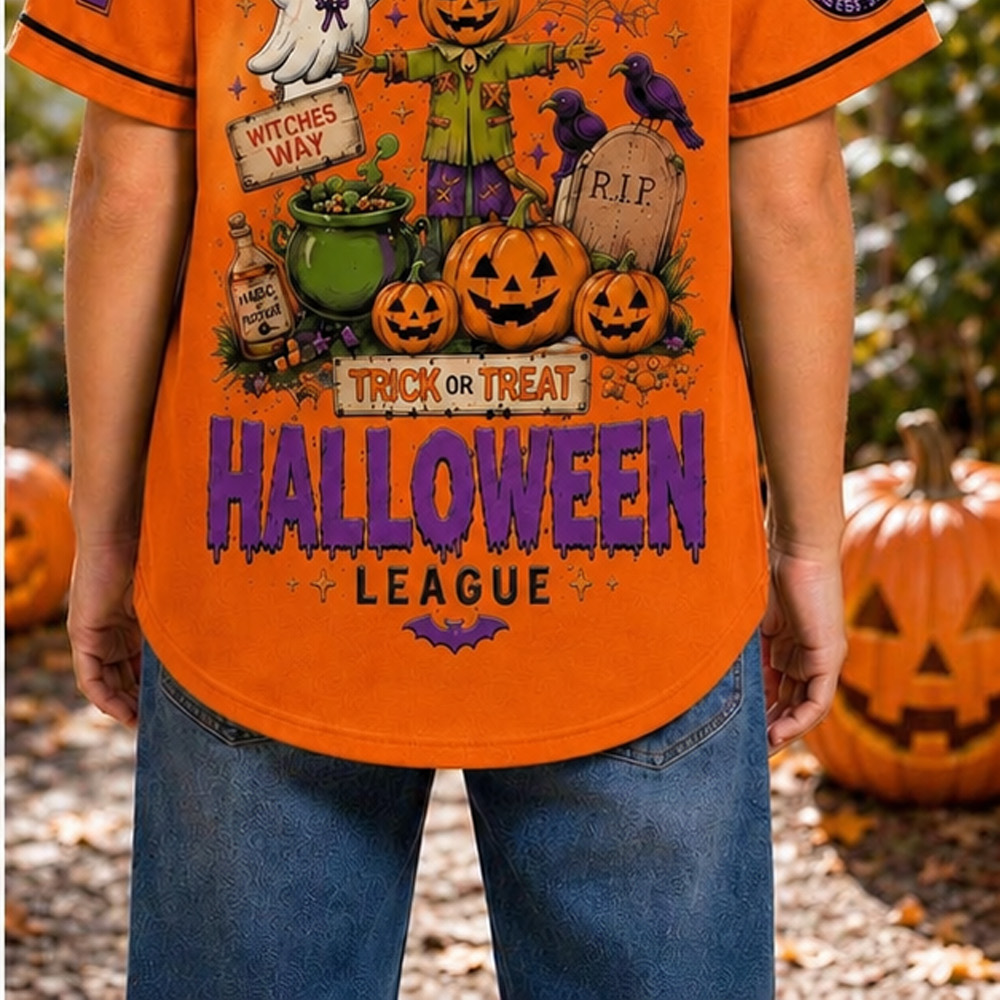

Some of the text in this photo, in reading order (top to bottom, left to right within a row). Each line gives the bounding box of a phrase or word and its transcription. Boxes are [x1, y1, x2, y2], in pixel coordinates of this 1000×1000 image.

[245, 103, 338, 148] WITCHES
[266, 131, 324, 168] WAY
[348, 365, 575, 403] TRICK OR TREAT
[206, 411, 705, 564] HALLOWEEN
[356, 565, 550, 605] LEAGUE
